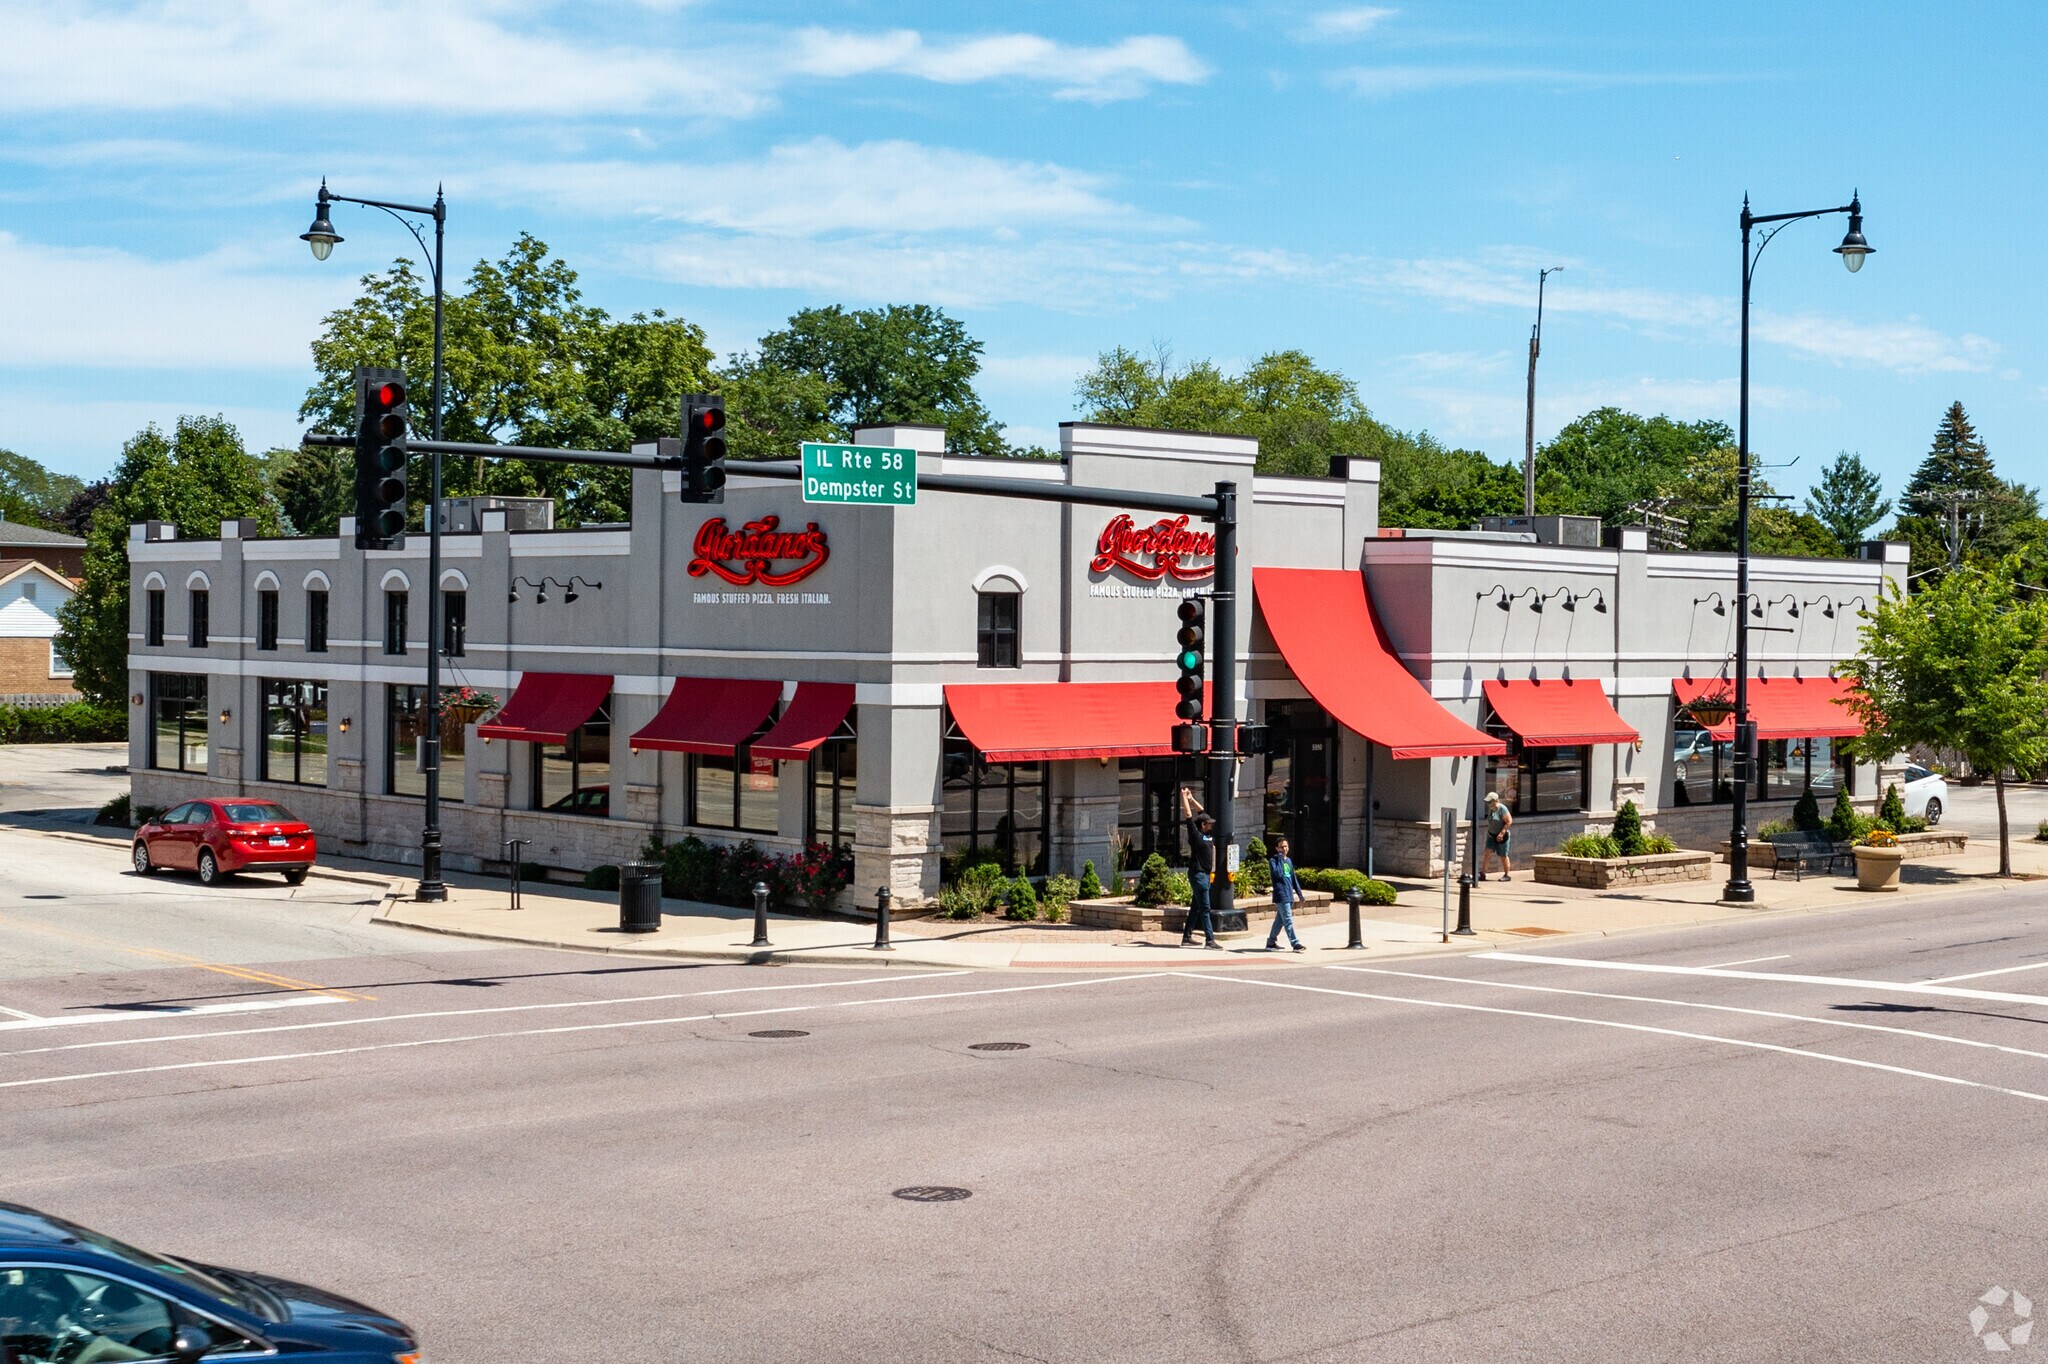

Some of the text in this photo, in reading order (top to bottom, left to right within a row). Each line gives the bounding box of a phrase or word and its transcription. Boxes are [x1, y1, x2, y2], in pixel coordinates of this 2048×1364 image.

[816, 449, 904, 471] IL Rte 58
[807, 477, 912, 501] Dempster St
[687, 515, 831, 587] Giordano's
[693, 592, 831, 604] FAMOUS STUFFED PIZZA. FRESH ITALIAN.
[1090, 585, 1121, 598] FAMOUS
[1122, 586, 1154, 599] STUFFED
